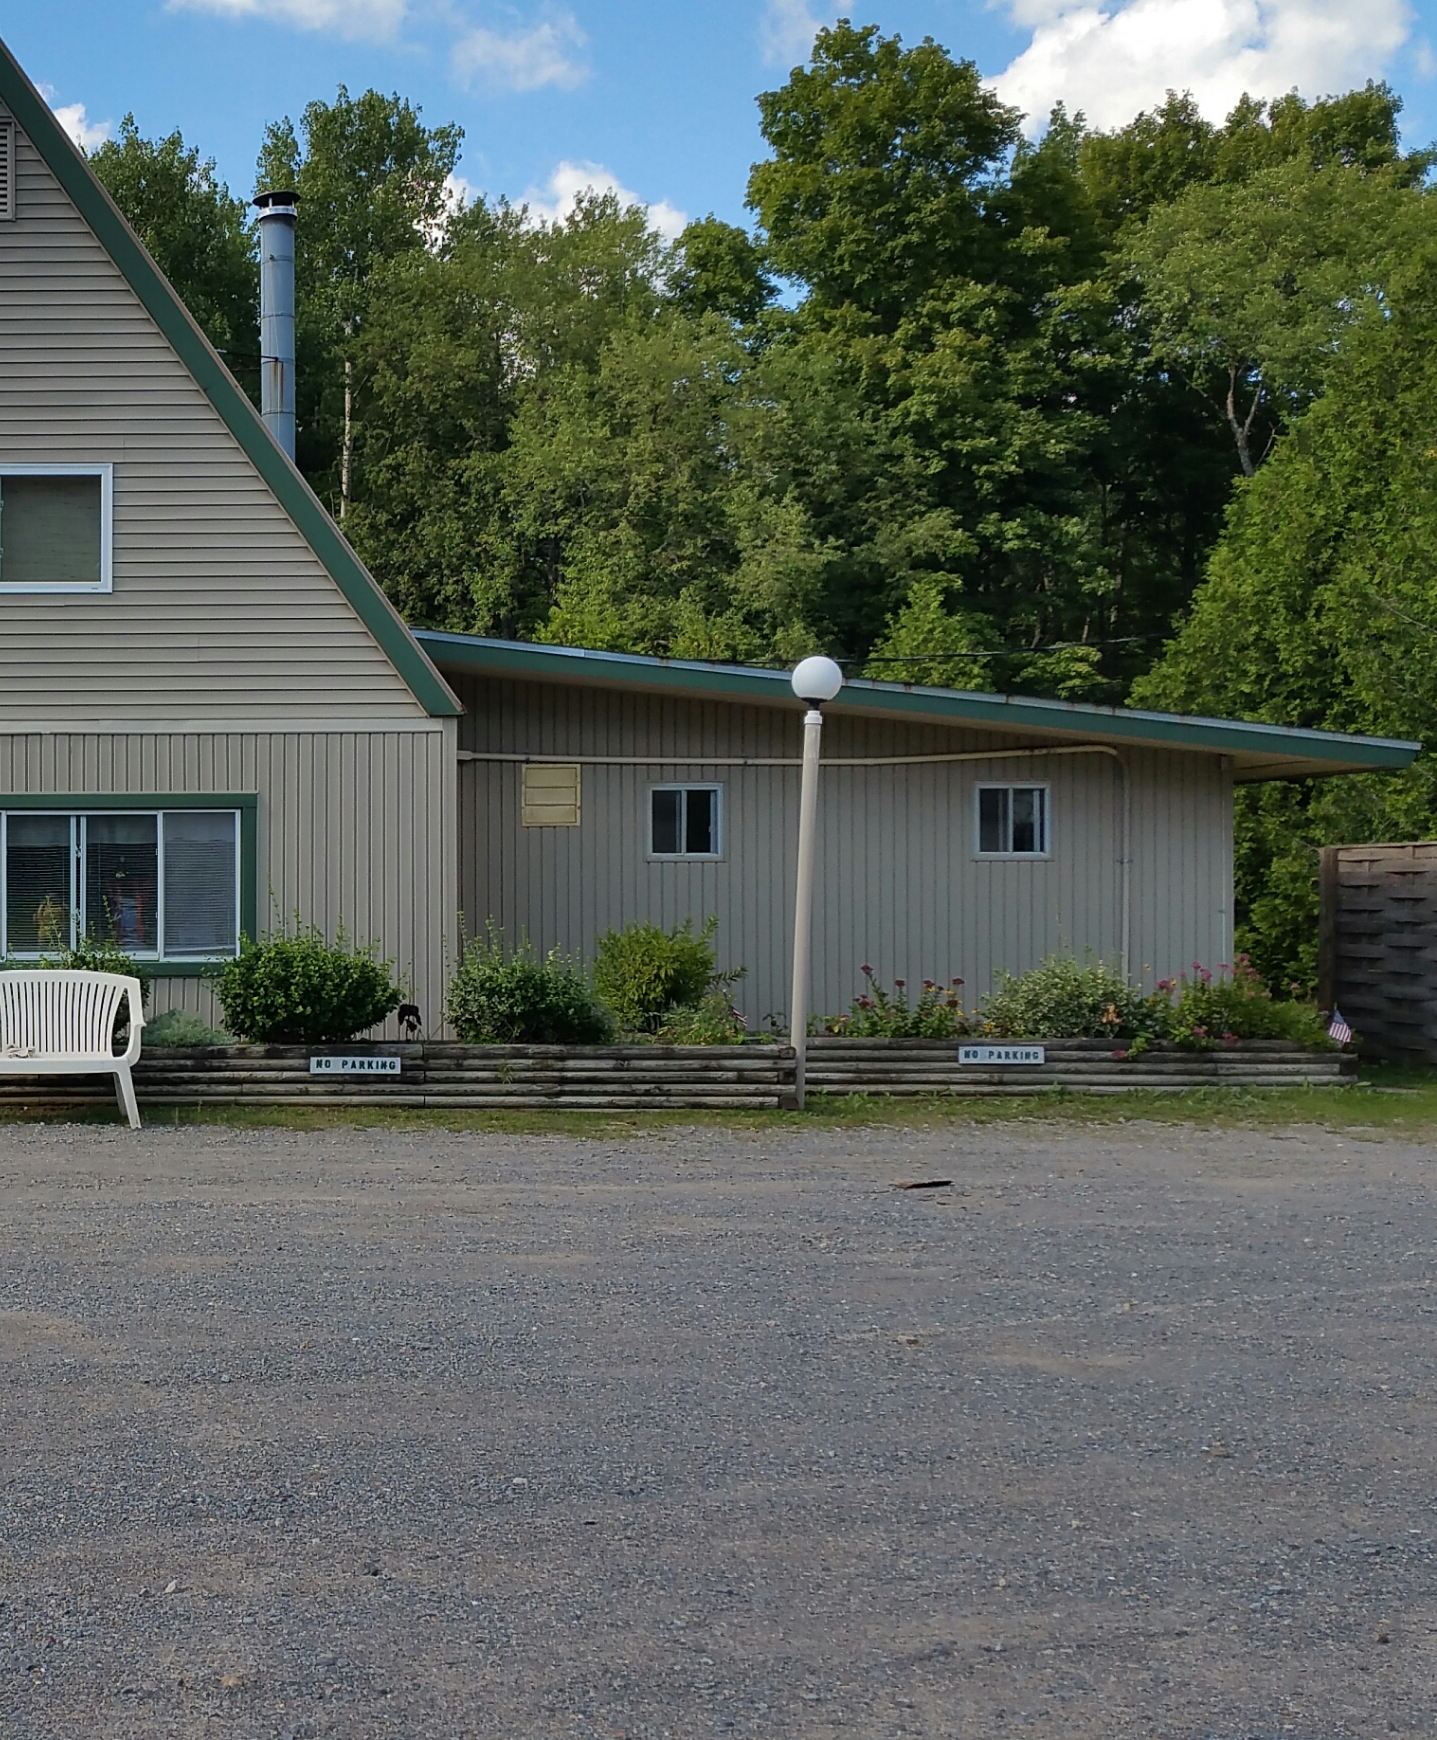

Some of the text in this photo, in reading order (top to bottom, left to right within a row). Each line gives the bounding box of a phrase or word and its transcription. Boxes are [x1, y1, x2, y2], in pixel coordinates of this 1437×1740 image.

[964, 1050, 1039, 1060] NO PARKING
[315, 1059, 396, 1070] NO PARKING
